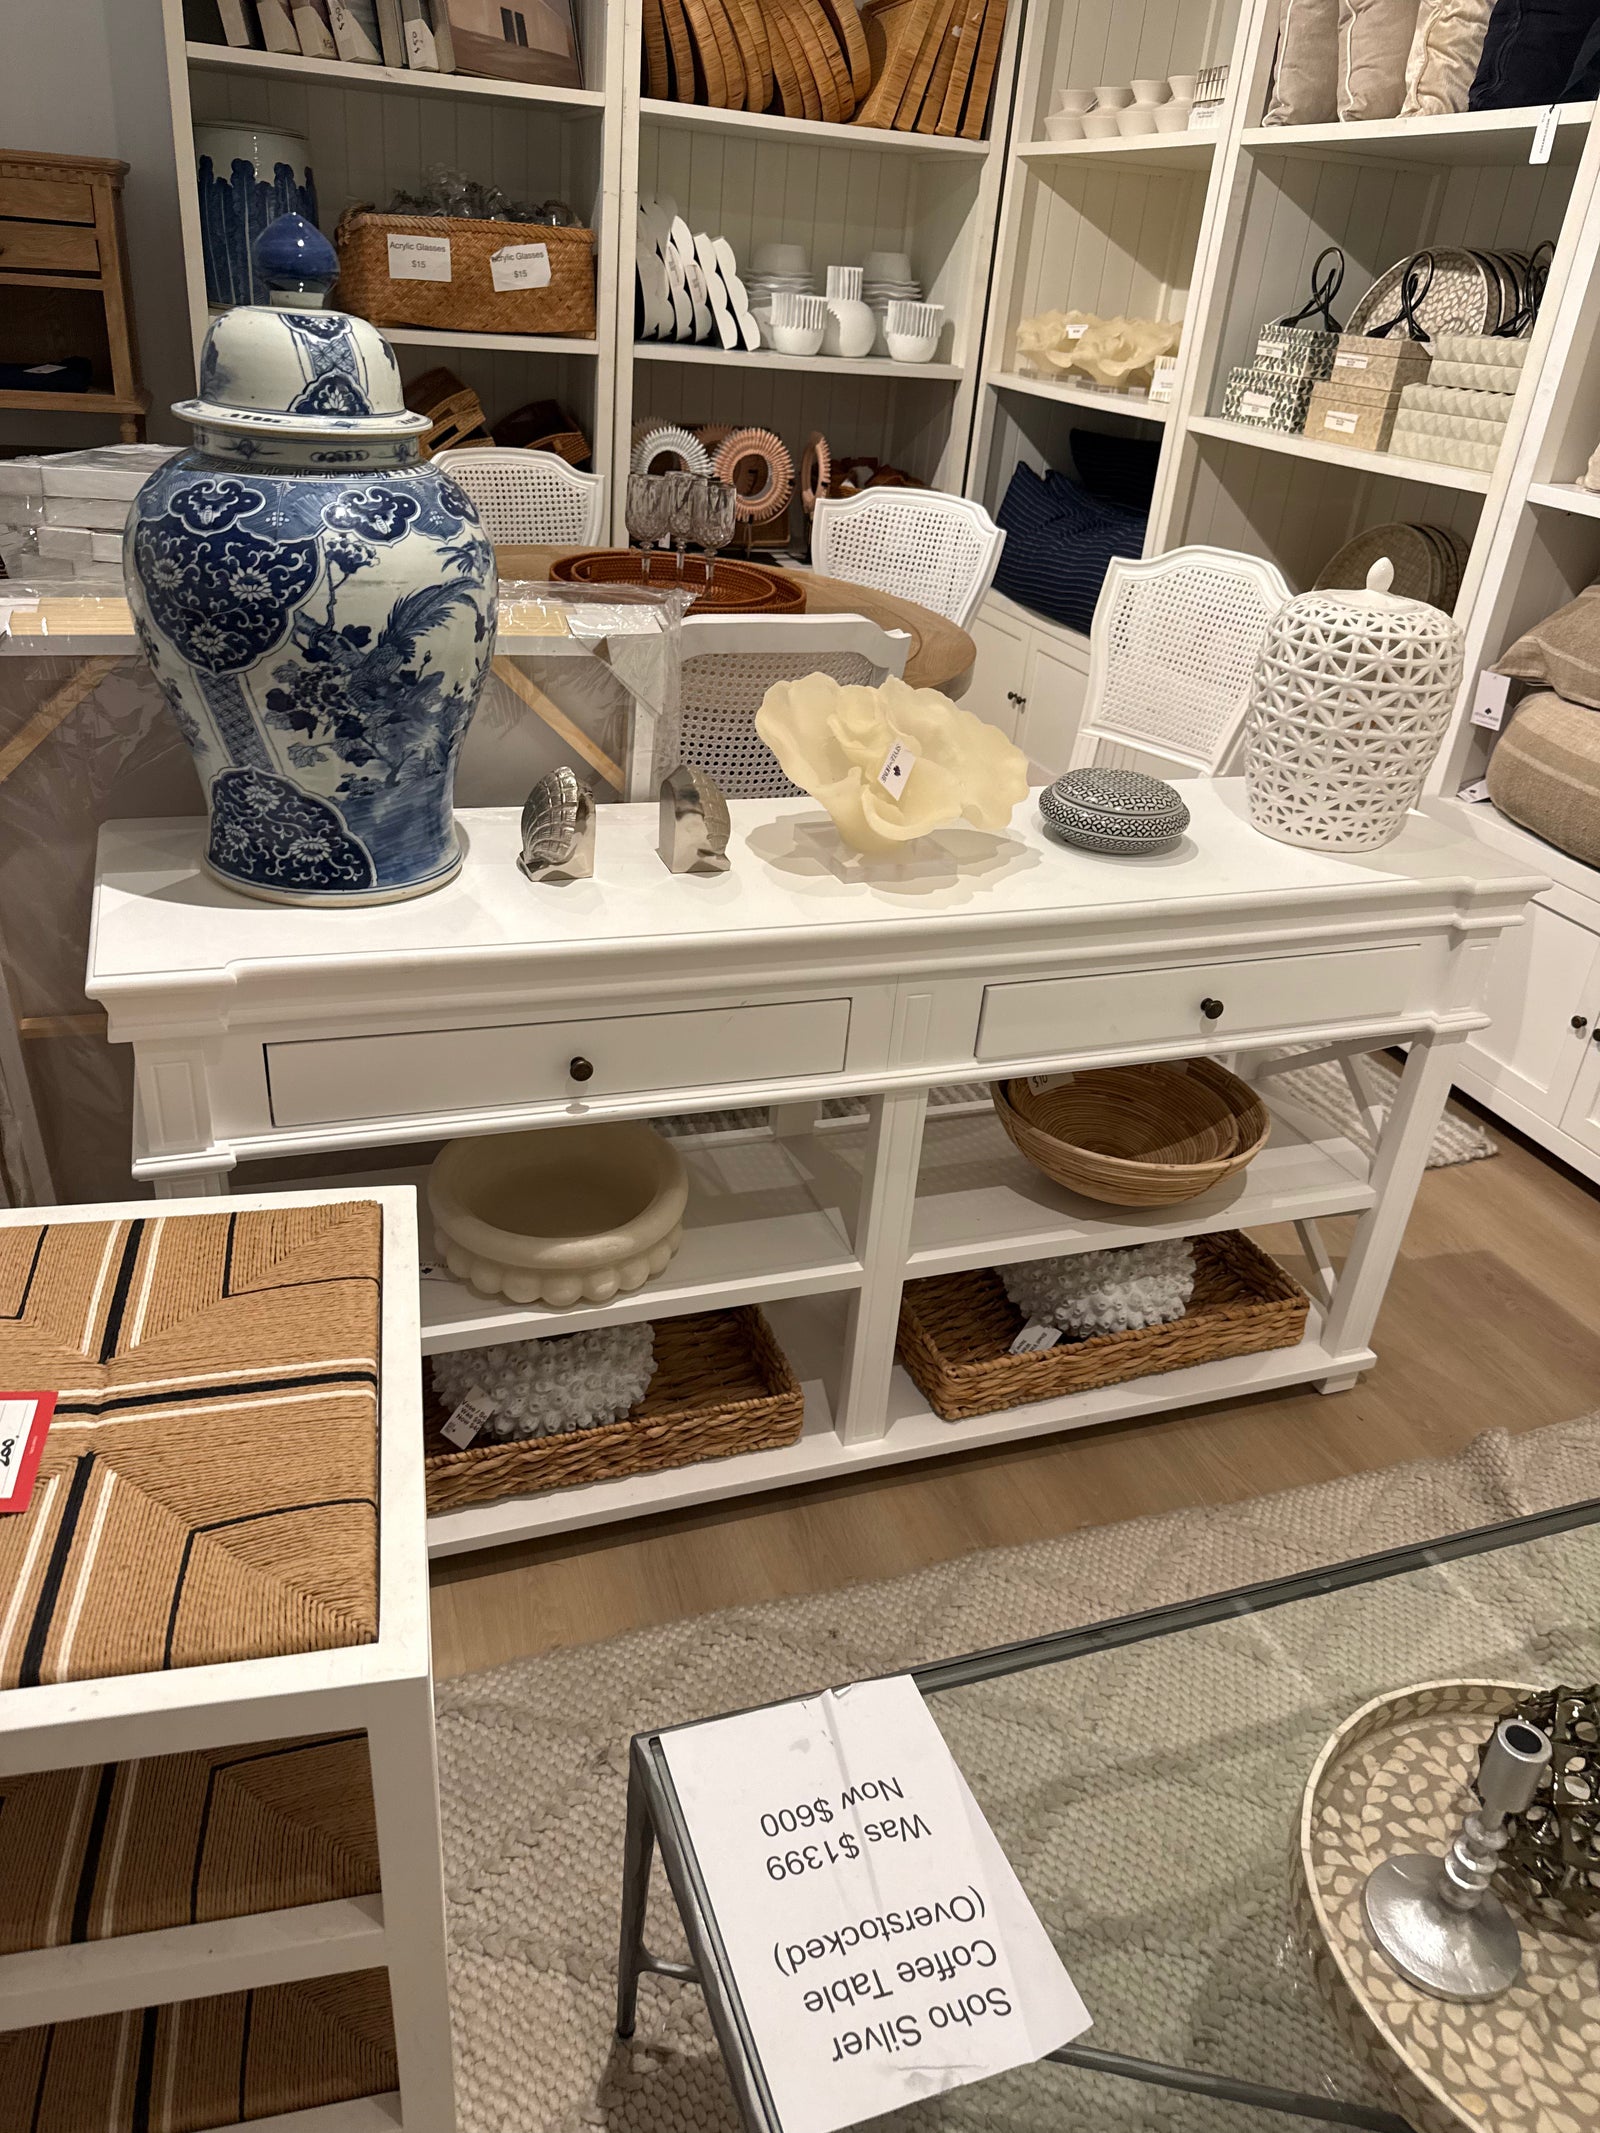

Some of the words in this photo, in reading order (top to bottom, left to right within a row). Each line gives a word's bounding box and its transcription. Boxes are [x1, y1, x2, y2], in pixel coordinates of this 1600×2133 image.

[389, 241, 415, 251] Acrylic
[416, 243, 446, 253] Glasses
[411, 259, 427, 269] $15
[516, 250, 545, 261] Glasses
[513, 269, 528, 279] $15
[841, 1776, 905, 1809] Now
[760, 1796, 834, 1837] $600
[863, 1814, 932, 1842] Was
[766, 1831, 860, 1881] $1399
[773, 1884, 986, 1977] (Overstocked)
[896, 1939, 998, 1982] Coffee
[803, 1968, 894, 2014] Table
[927, 1986, 1013, 2029] Soho
[832, 2014, 922, 2063] Silver
